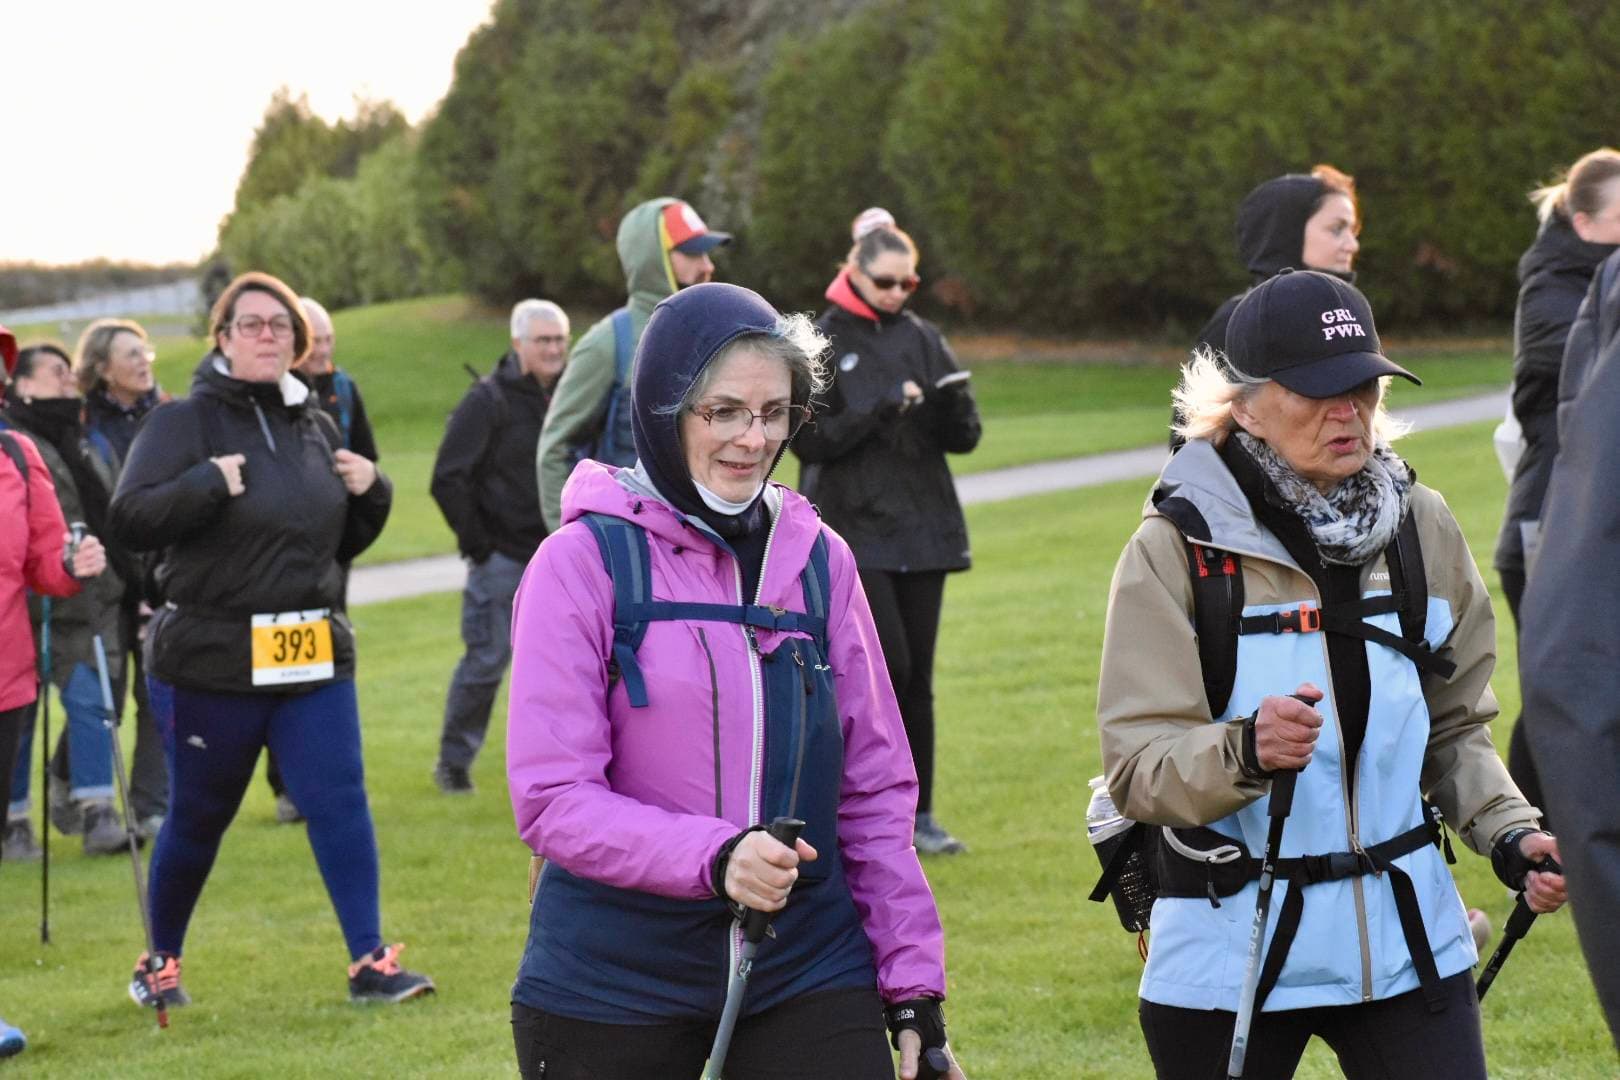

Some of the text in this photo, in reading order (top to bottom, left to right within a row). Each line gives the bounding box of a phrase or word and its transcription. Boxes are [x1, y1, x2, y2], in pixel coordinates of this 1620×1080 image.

[1321, 309, 1357, 324] GRL
[1322, 324, 1366, 340] PWR
[273, 628, 316, 662] 393
